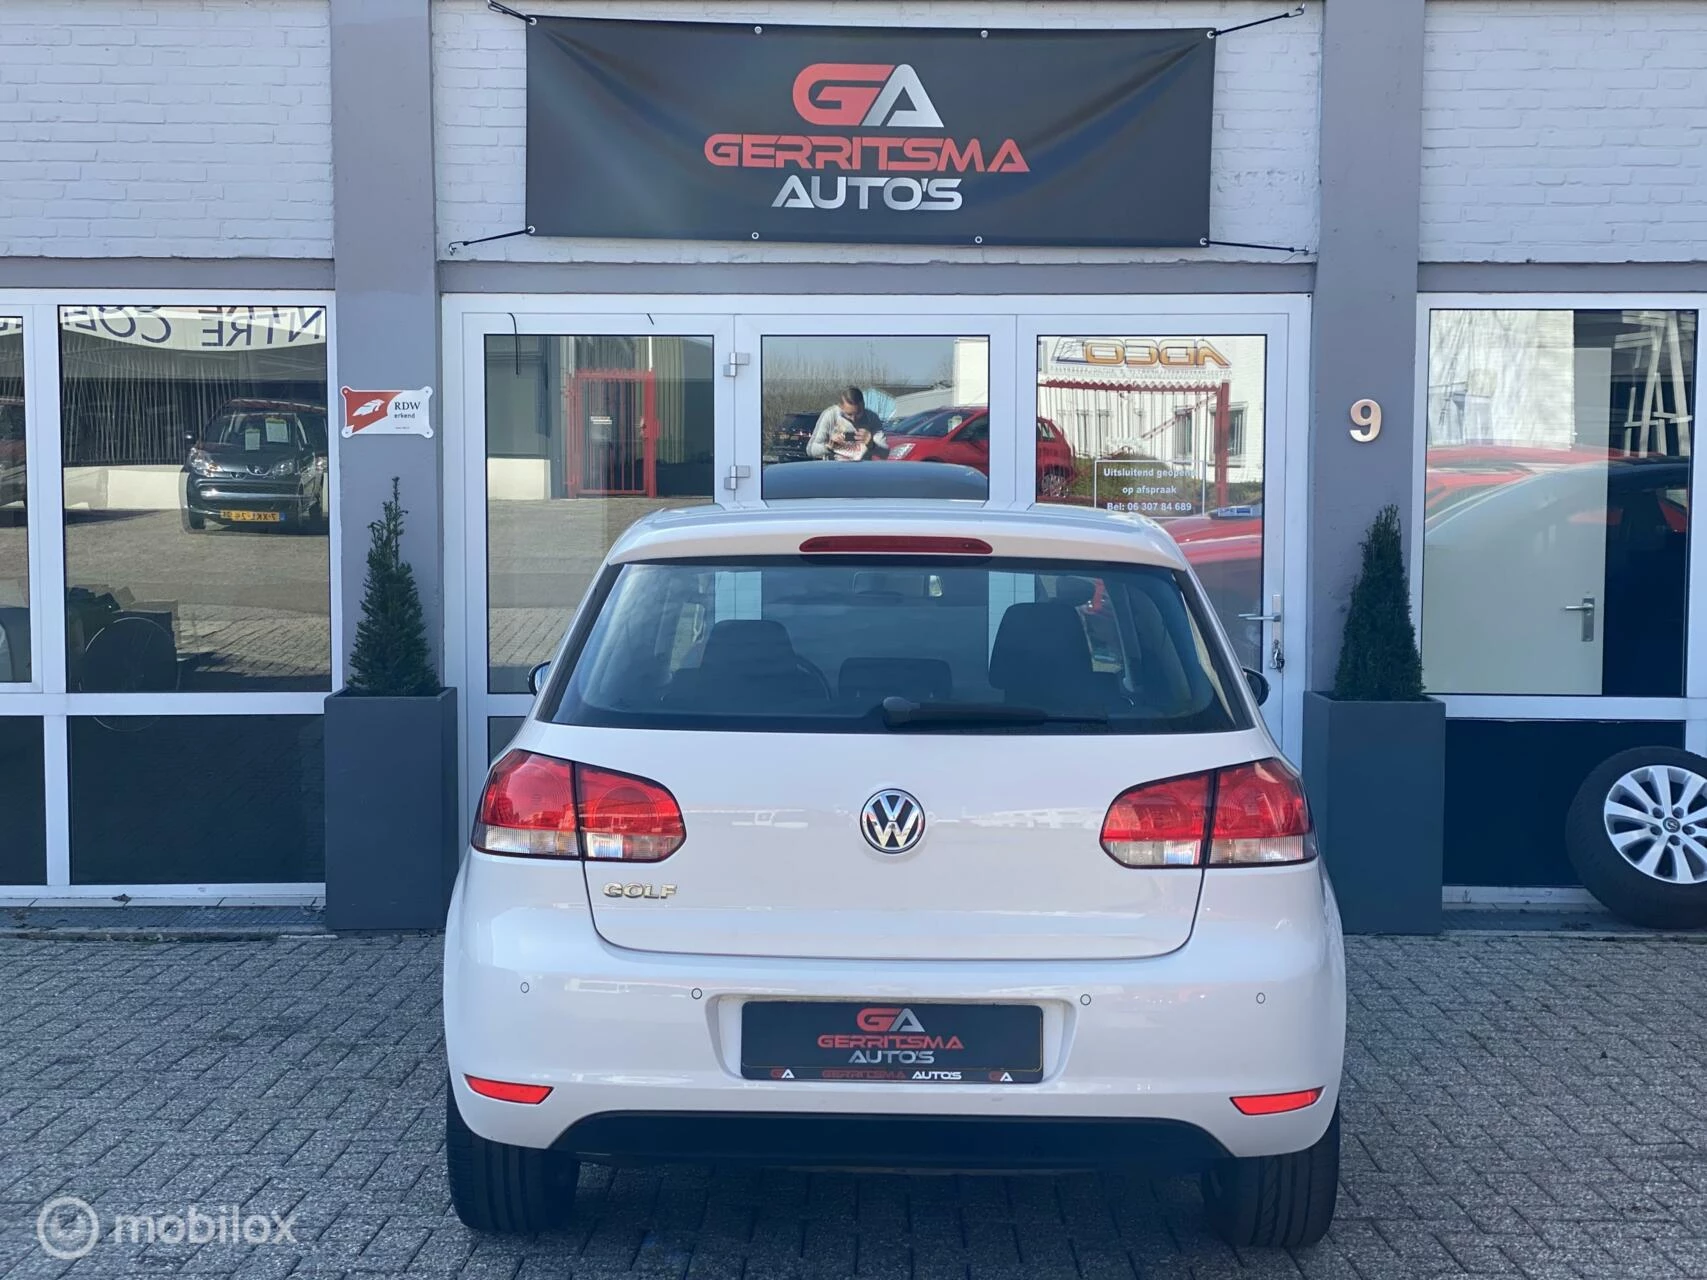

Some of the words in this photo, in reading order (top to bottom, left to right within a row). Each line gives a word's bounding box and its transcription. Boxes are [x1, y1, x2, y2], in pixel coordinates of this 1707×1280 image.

[793, 63, 944, 127] GA
[704, 133, 1030, 173] GERRITSMA
[771, 175, 963, 211] AUTO'S
[394, 402, 420, 410] RDW
[1350, 399, 1382, 442] 9
[1104, 468, 1154, 477] Uitsluitend
[1122, 487, 1134, 495] op
[1137, 485, 1177, 495] afspraak
[1107, 503, 1125, 511] Bel:
[1127, 503, 1139, 511] 06
[1141, 503, 1158, 511] 307
[1161, 503, 1172, 511] 84
[1175, 503, 1192, 511] 689
[603, 882, 677, 899] GOLF
[817, 1035, 964, 1049] GERRITSMA
[848, 1050, 934, 1064] AUTO'S
[822, 1070, 906, 1079] GERRITSMA
